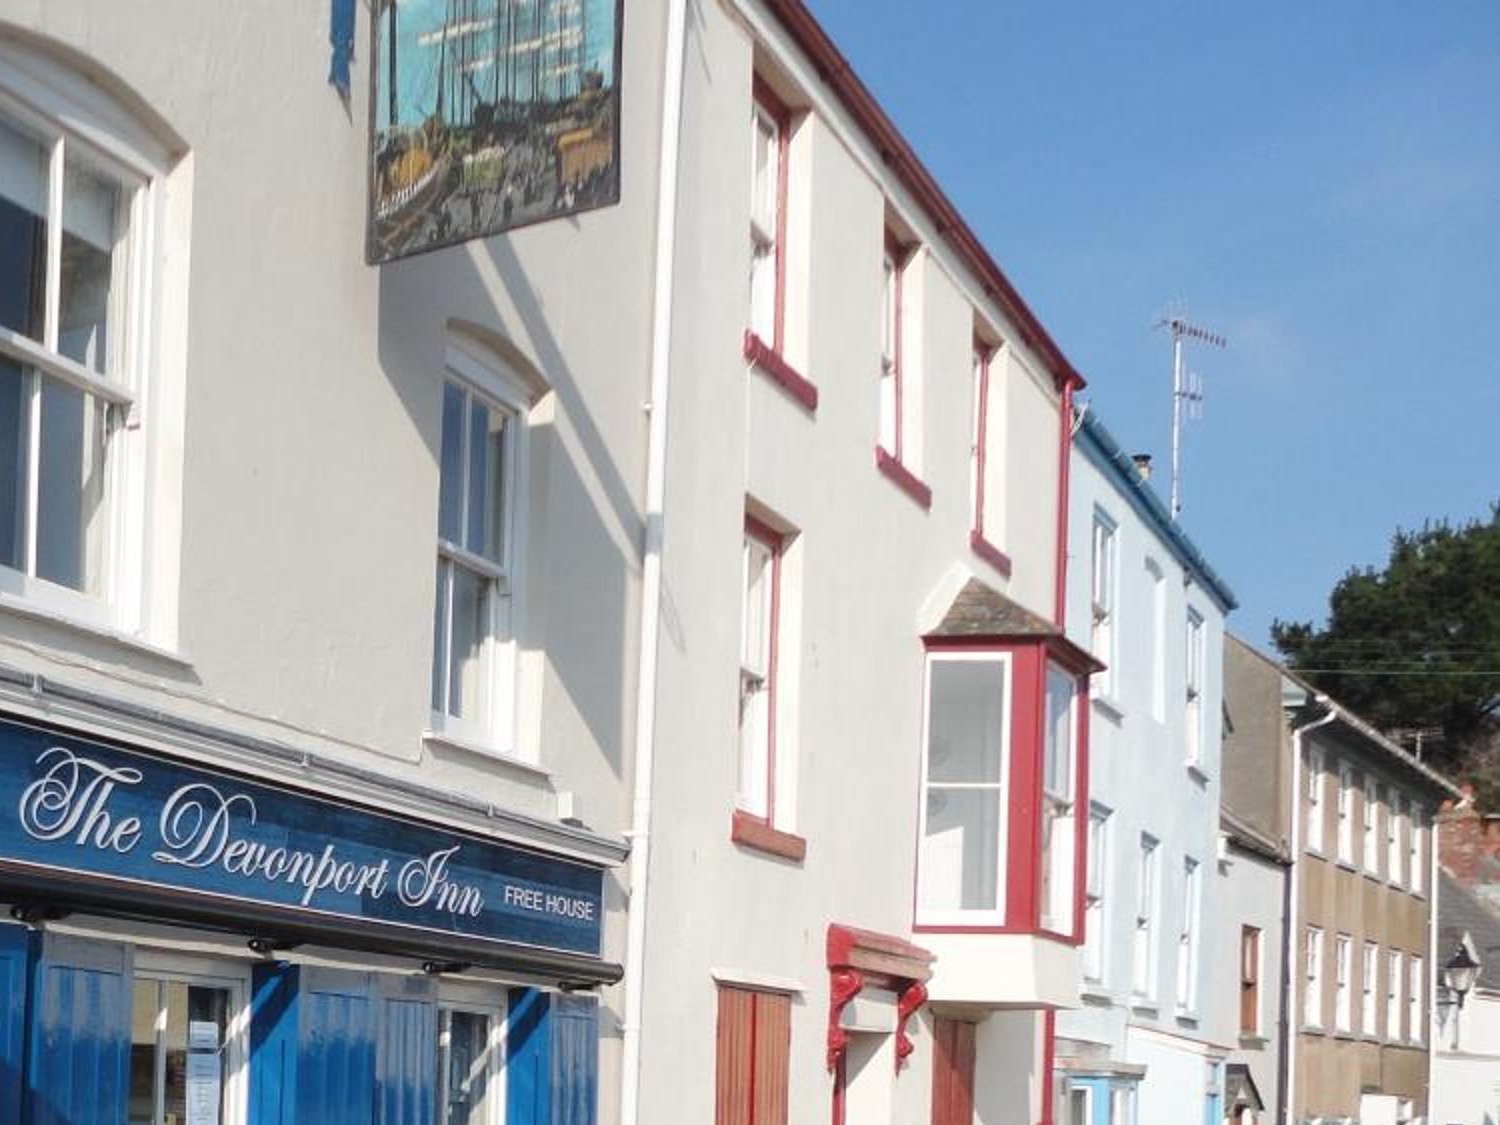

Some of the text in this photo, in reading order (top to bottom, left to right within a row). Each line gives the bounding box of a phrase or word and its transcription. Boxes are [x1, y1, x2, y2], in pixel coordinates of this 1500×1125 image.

[19, 746, 484, 918] The Devonport Inn
[504, 884, 595, 921] FREE HOUSE
